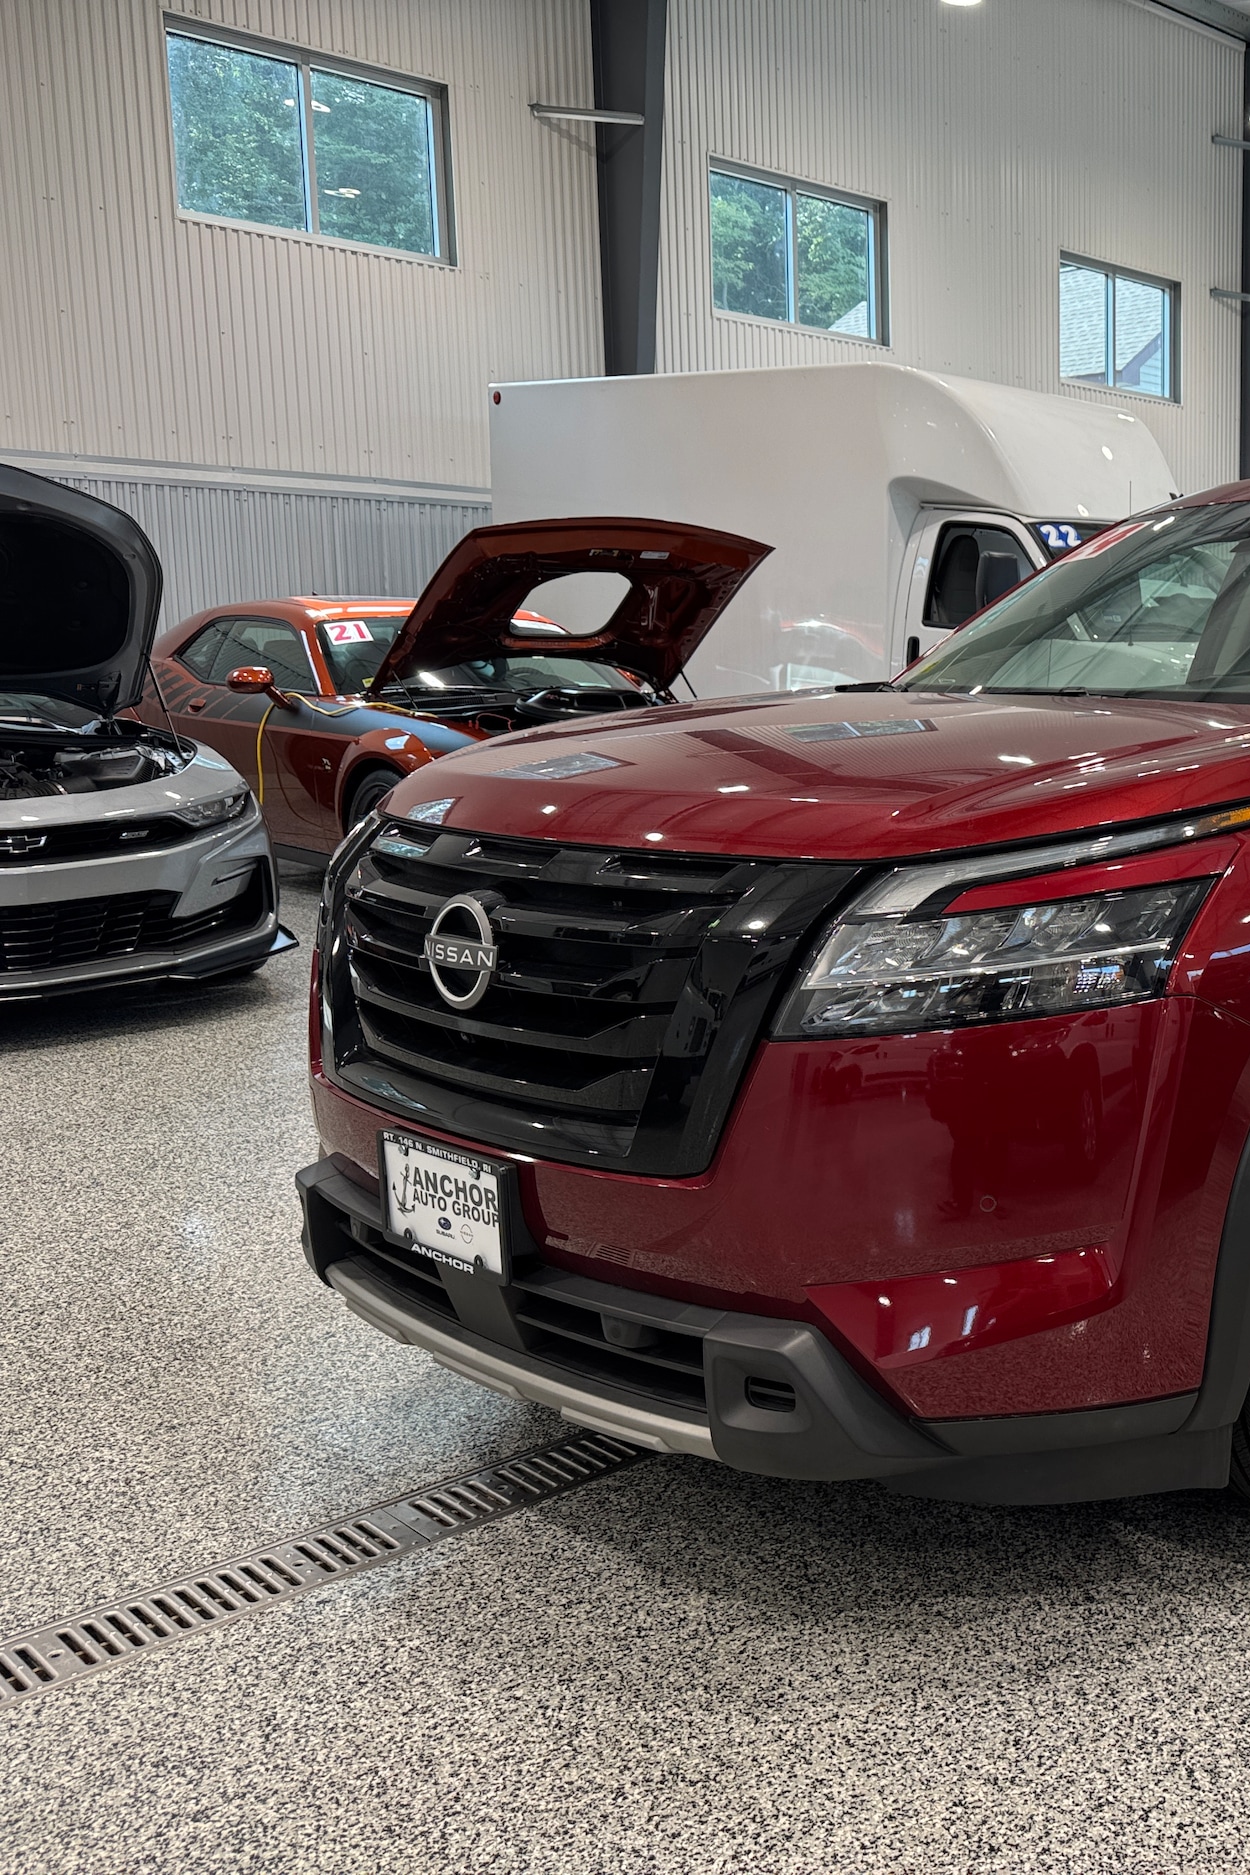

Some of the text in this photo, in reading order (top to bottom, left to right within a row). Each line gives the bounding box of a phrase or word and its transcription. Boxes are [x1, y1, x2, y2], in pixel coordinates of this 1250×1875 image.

[1040, 524, 1082, 547] 22
[329, 623, 367, 641] 21
[425, 939, 493, 967] NISSAN
[383, 1131, 492, 1173] RT. 146 N. SMITHFIELD, RI
[412, 1166, 499, 1212] ANCHOR
[413, 1188, 500, 1228] AUTO GROUP
[411, 1243, 475, 1275] ANCHOR
